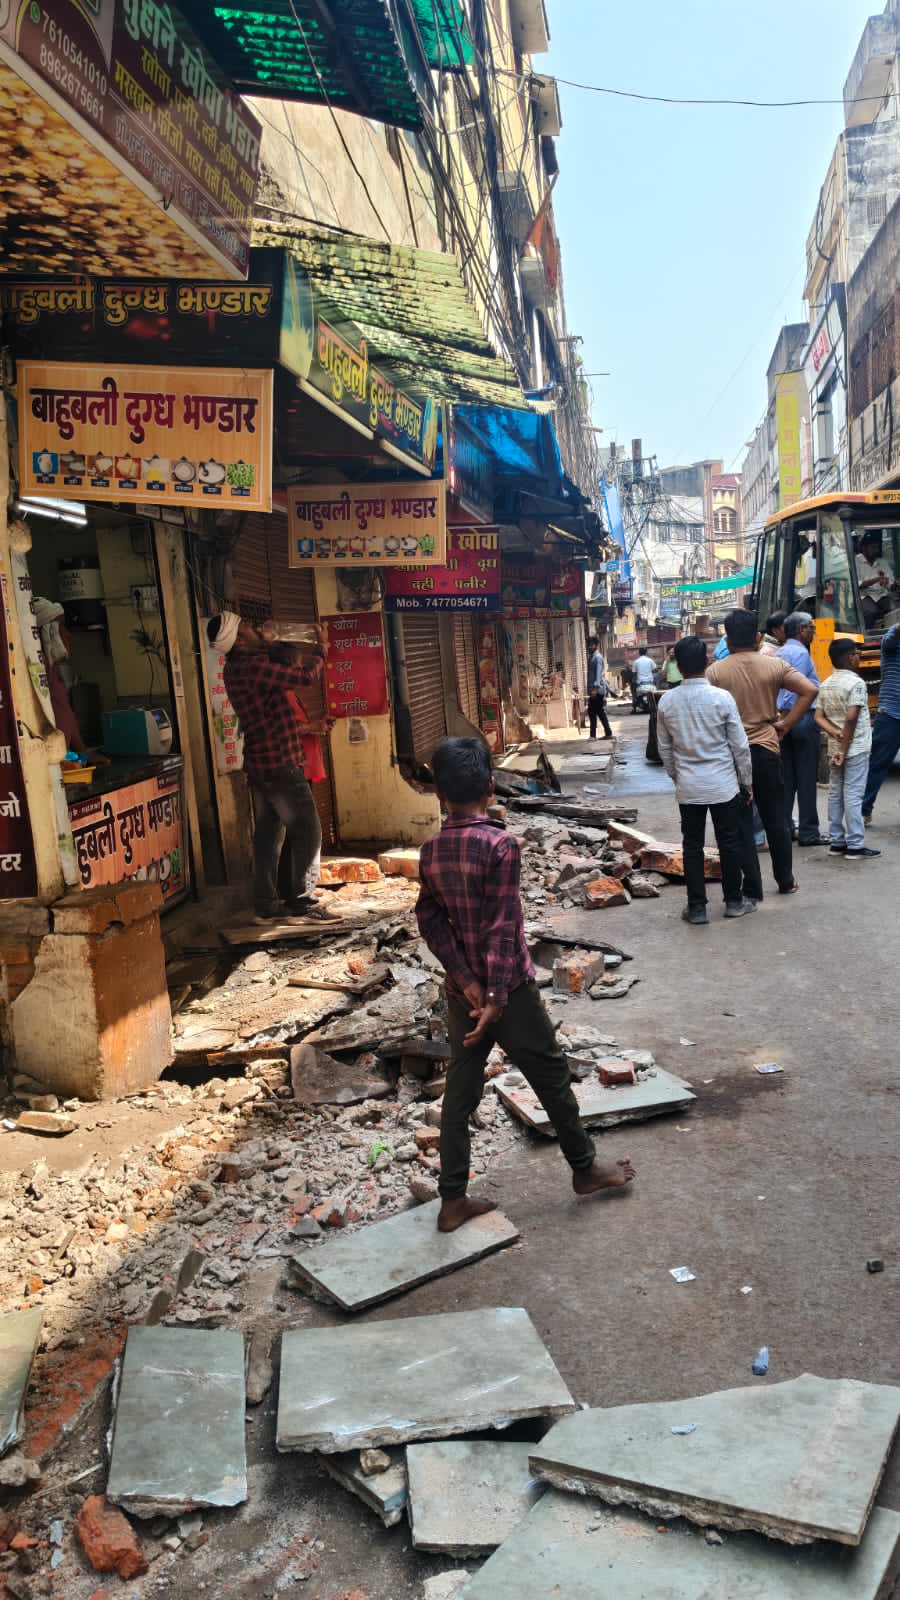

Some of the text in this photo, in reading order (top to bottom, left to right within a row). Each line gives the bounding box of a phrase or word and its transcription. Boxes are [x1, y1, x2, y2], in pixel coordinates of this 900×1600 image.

[42, 10, 107, 96] 7610541010
[40, 43, 104, 124] 8962675661
[4, 277, 273, 326] ाहुबली दुग्ध भण्डार
[29, 376, 258, 444] बाहुबली दुग्ध भण्डार
[296, 491, 438, 530] बाहुबली दुग्ध भण्डार
[396, 597, 488, 608] Mob. 7477054671
[454, 576, 488, 590] पनीर
[117, 803, 146, 865] दुग्ध
